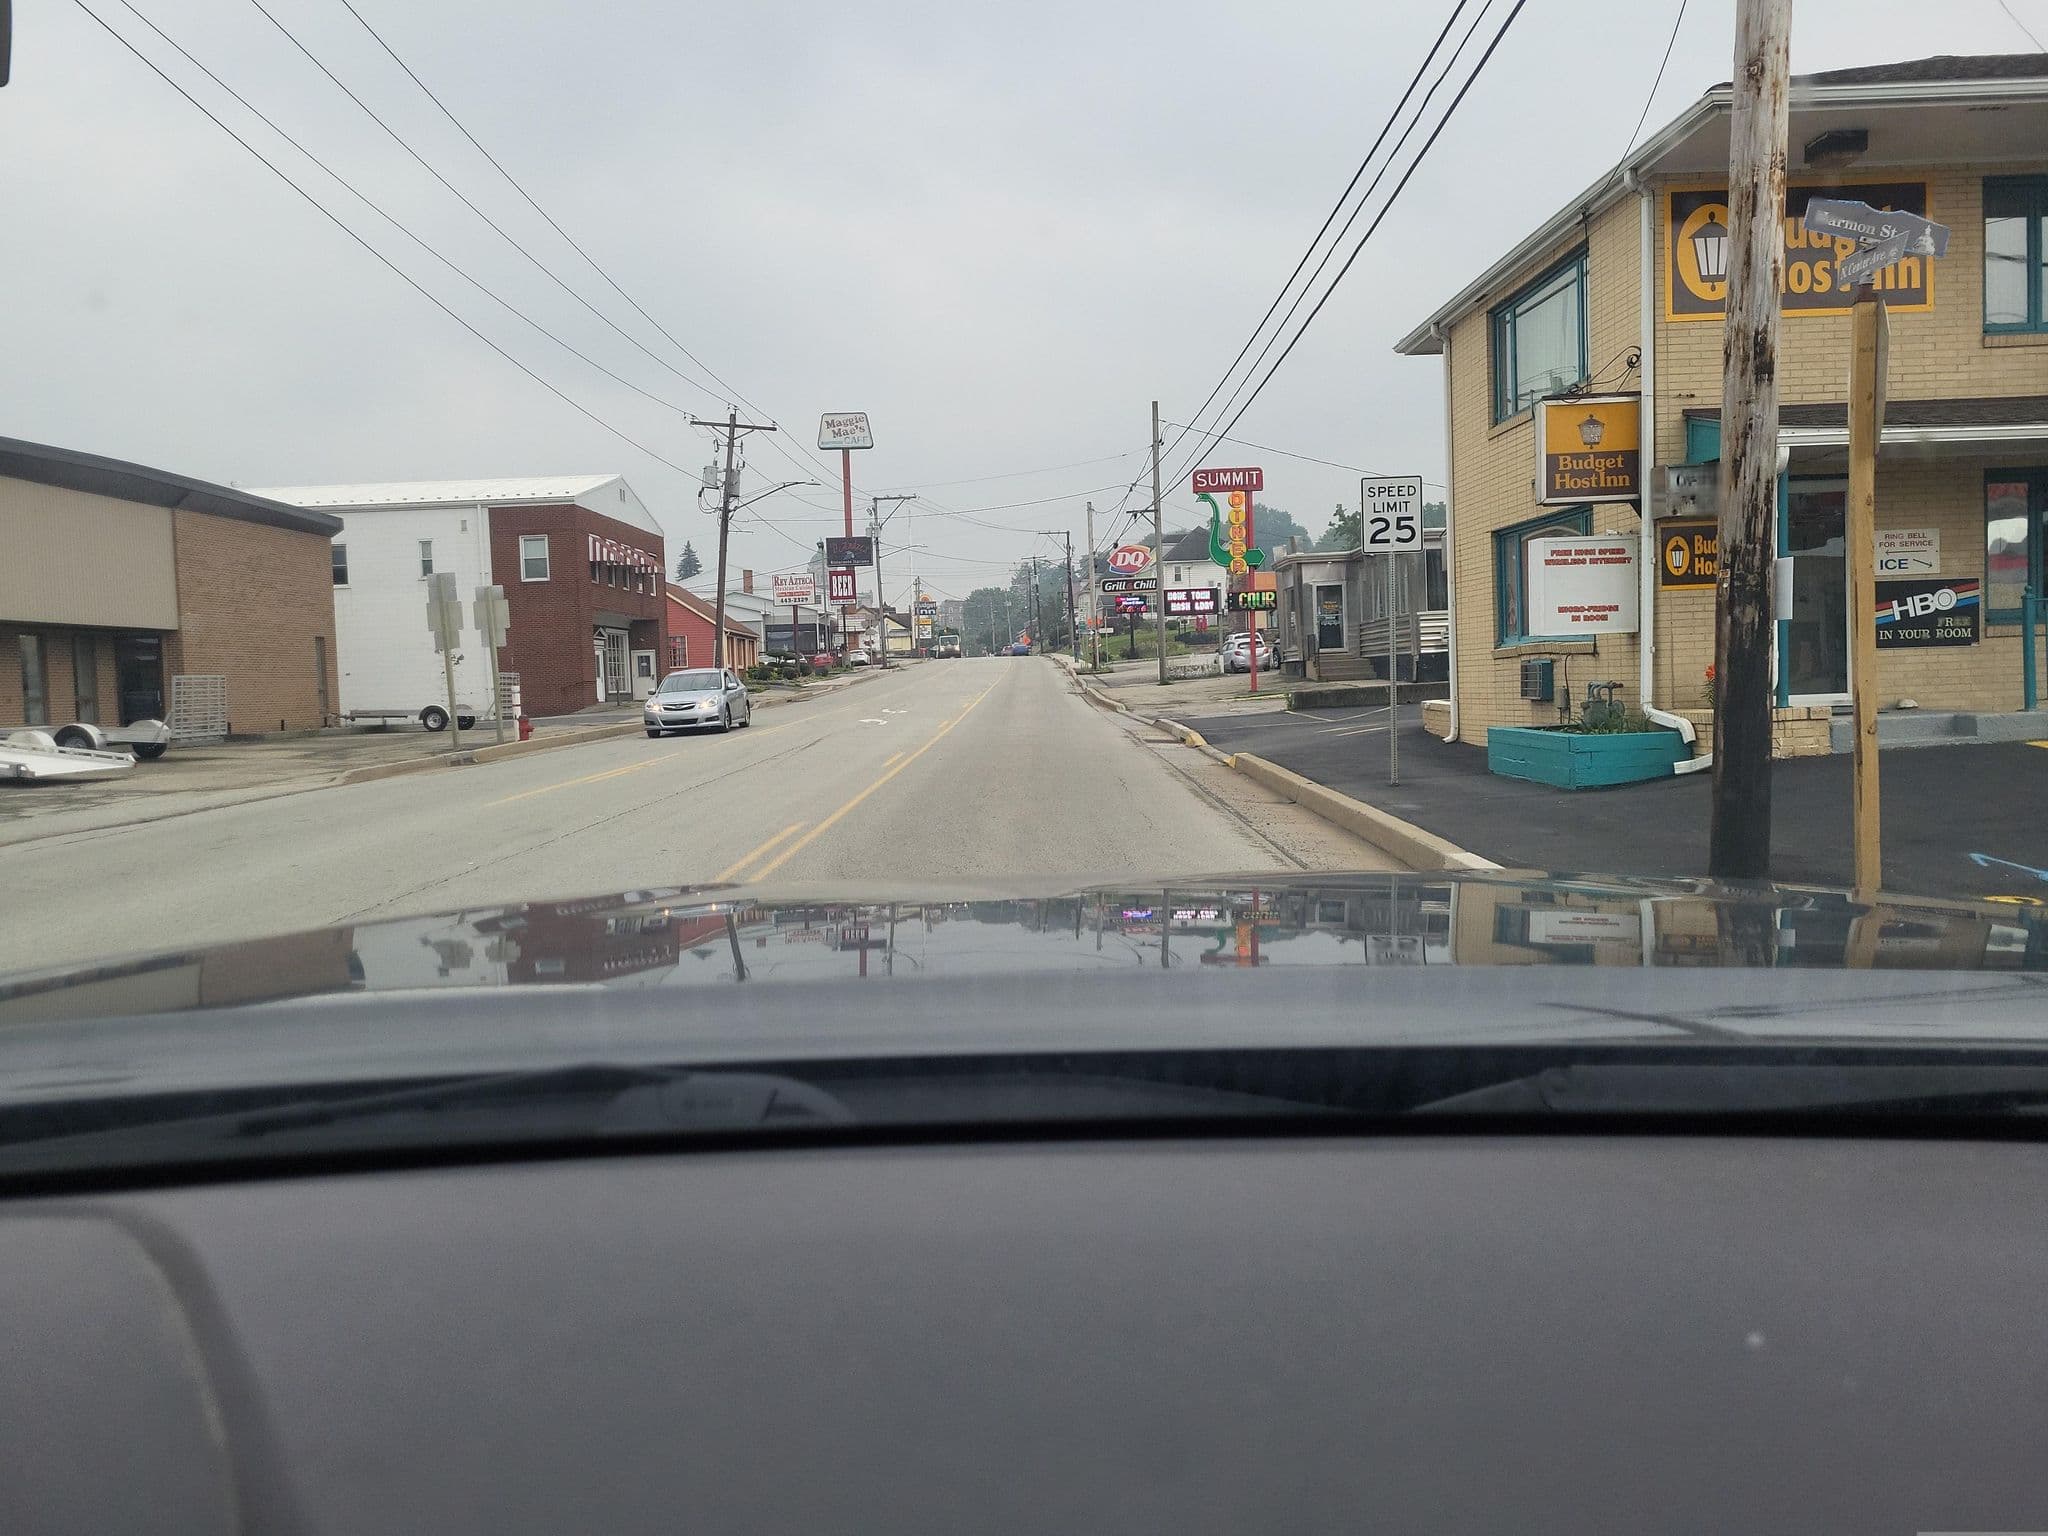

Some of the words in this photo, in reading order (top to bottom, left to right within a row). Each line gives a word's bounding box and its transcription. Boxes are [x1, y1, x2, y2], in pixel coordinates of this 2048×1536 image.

[1815, 210, 1875, 235] armon
[1880, 224, 1898, 238] St
[824, 415, 865, 429] Maggie
[1558, 454, 1625, 472] Budget
[1196, 471, 1260, 487] SUMMIT
[1554, 473, 1598, 490] Host
[1600, 471, 1631, 487] Inn
[1367, 485, 1417, 498] SPEED
[1373, 501, 1411, 514] LIMIT
[1229, 492, 1245, 574] DINER
[1369, 516, 1417, 545] 25
[1694, 534, 1718, 555] Bud
[1899, 540, 1934, 548] SERVICE
[1115, 551, 1145, 568] DQ
[1694, 557, 1719, 576] Hos
[1880, 559, 1909, 570] ICE
[832, 575, 853, 597] BEER
[1104, 581, 1126, 591] Grill
[1133, 579, 1156, 590] Chill
[1892, 588, 1957, 621] HBO
[1879, 630, 1893, 640] IN
